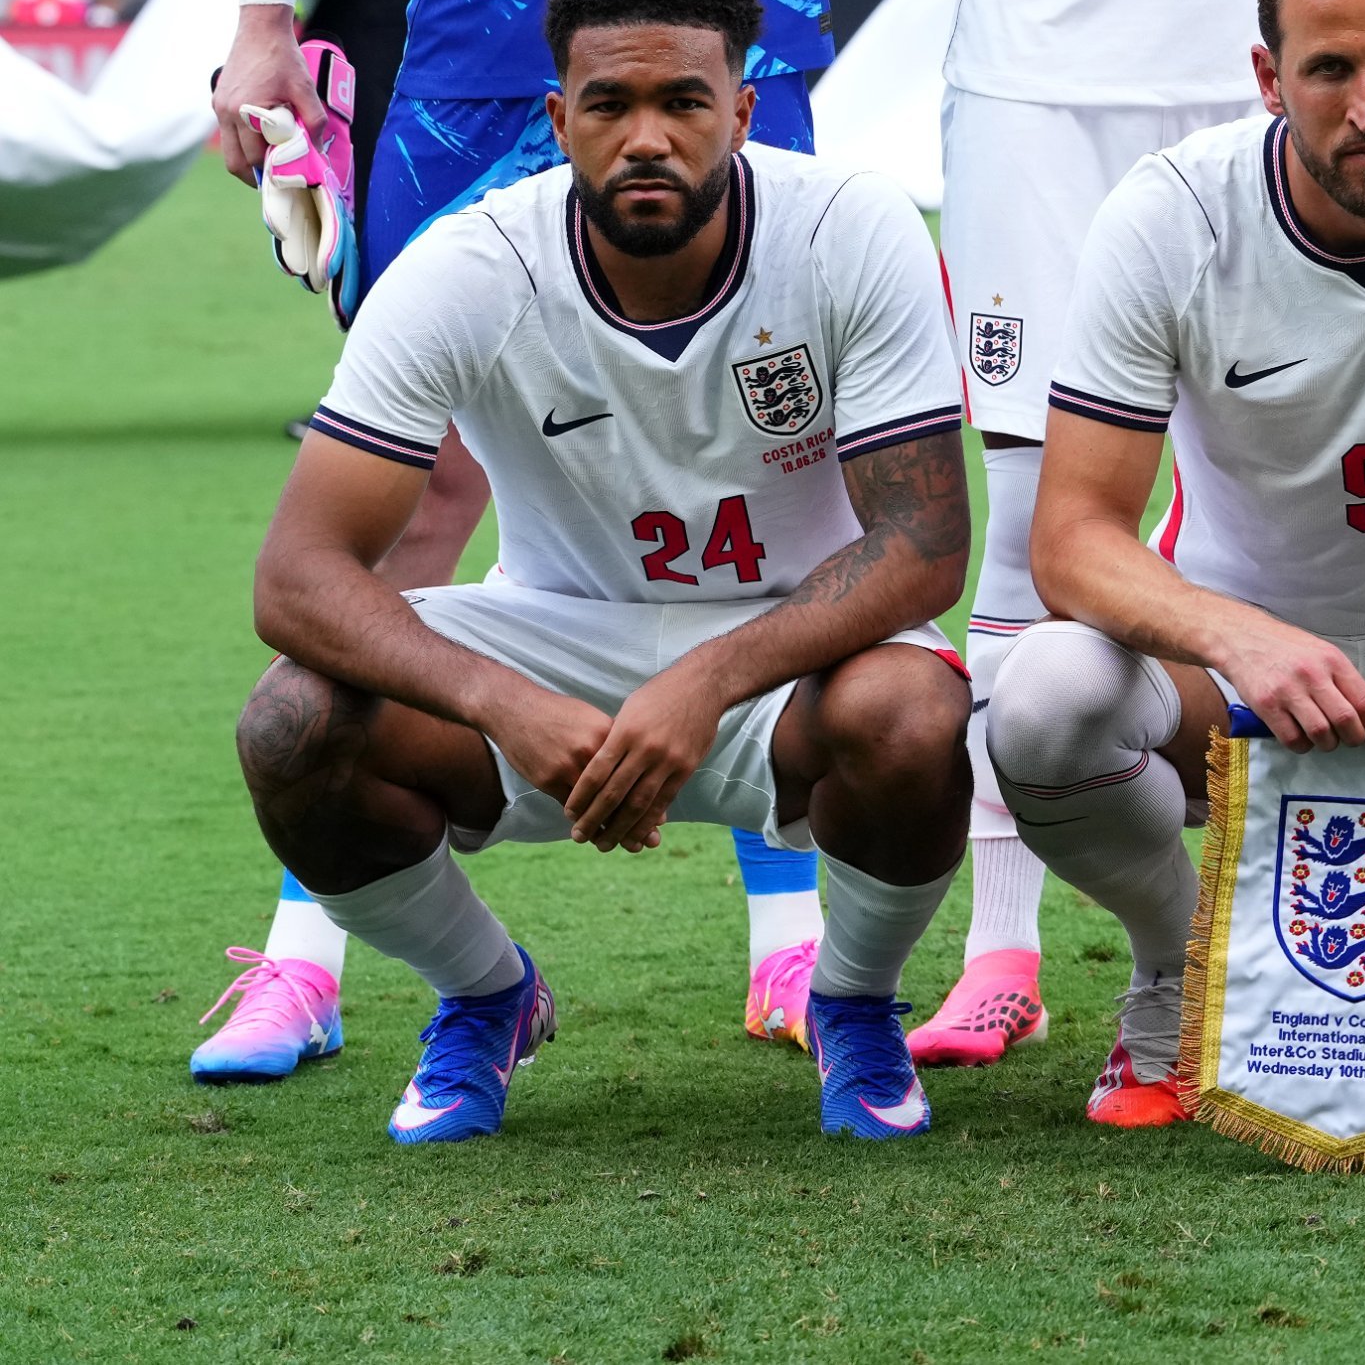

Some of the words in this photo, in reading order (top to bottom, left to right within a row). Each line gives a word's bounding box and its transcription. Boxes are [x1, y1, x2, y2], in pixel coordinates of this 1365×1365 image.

[762, 441, 805, 465] COSTA
[805, 427, 835, 449] RICA
[781, 447, 827, 475] 10.06.26
[631, 494, 766, 586] 24
[1272, 1011, 1329, 1028] England
[1334, 1016, 1344, 1027] v
[1250, 1043, 1317, 1060] Inter&Co
[1247, 1060, 1334, 1080] Wednesday
